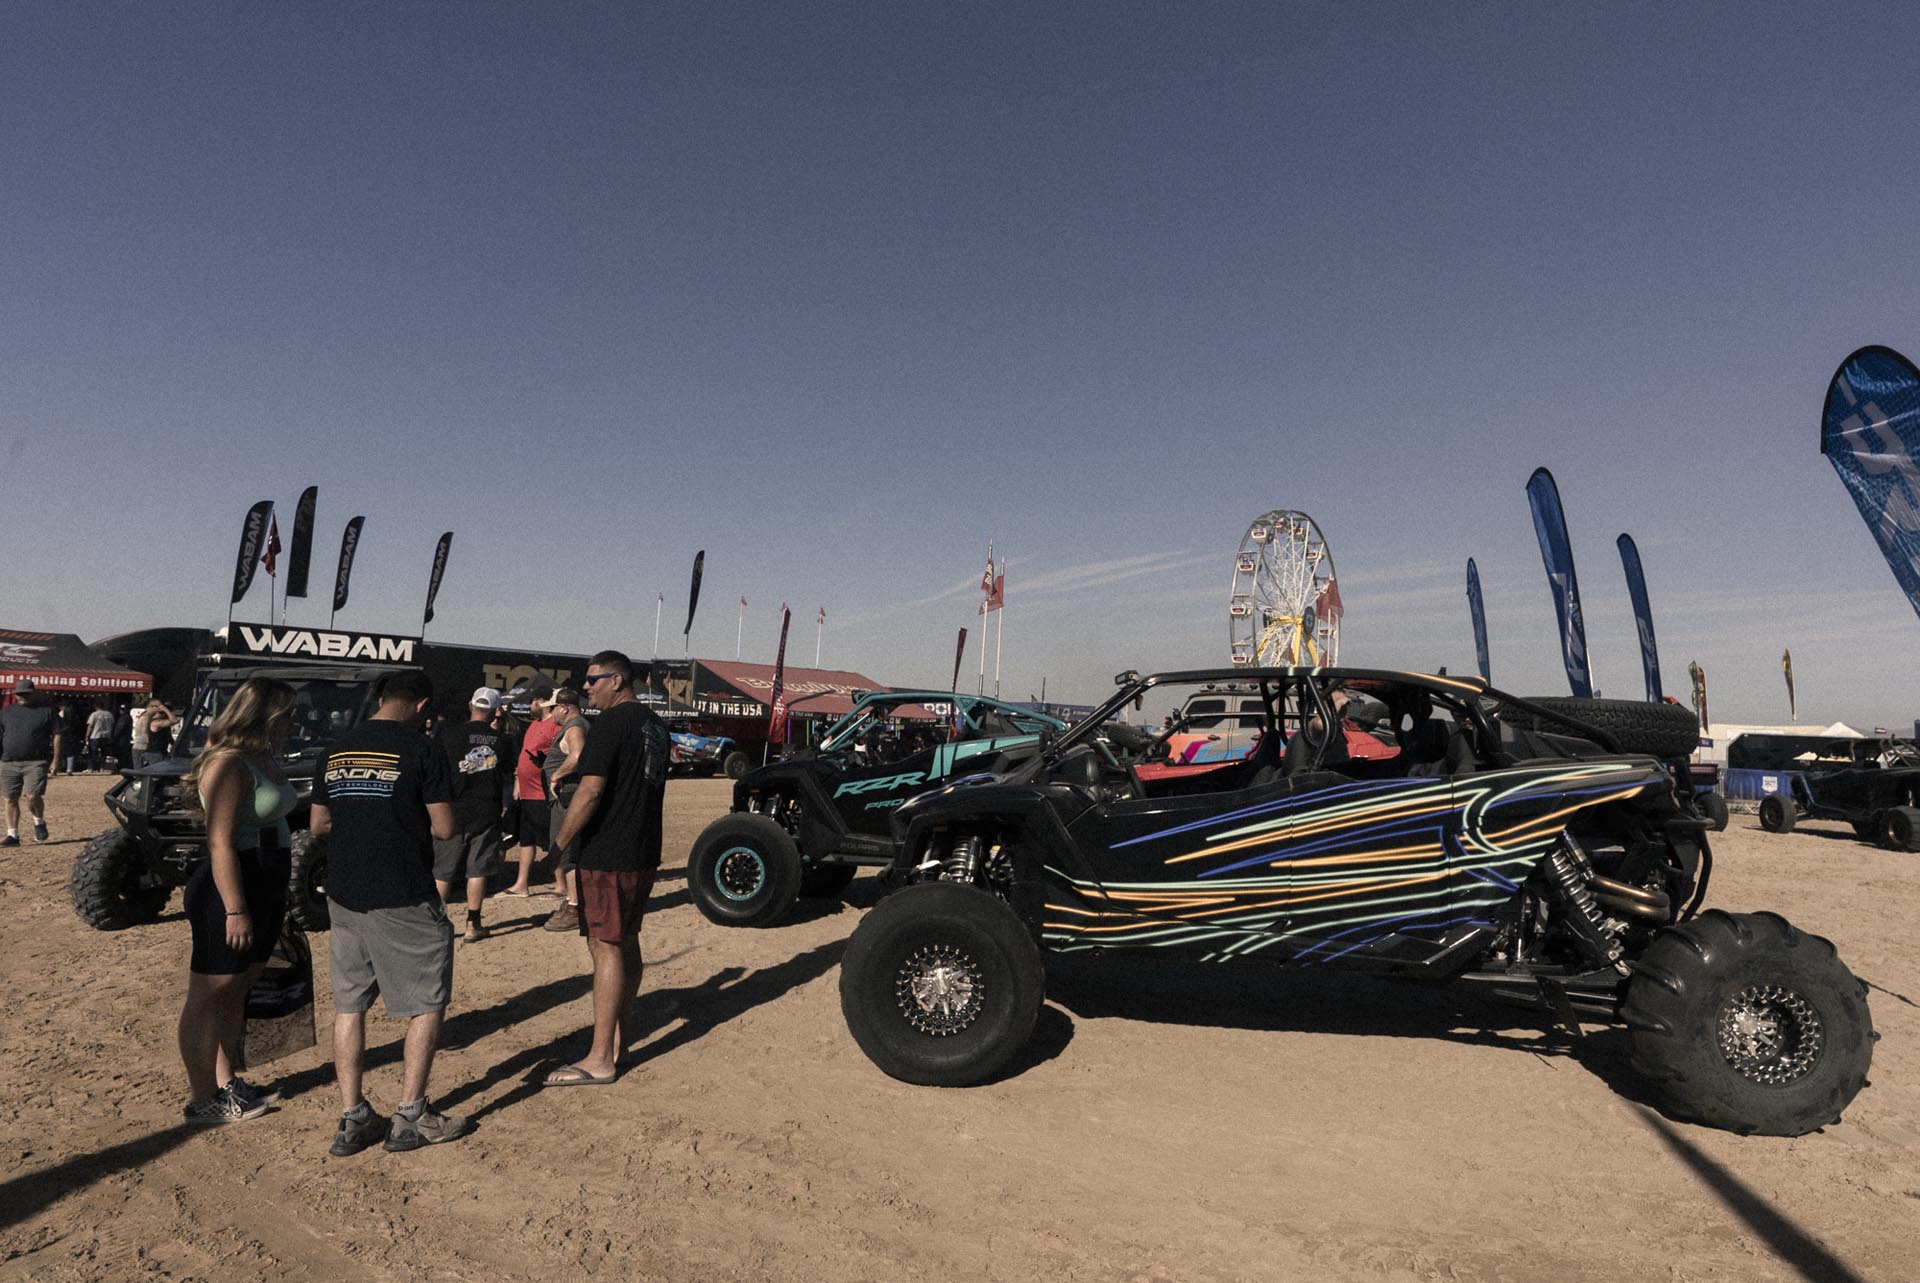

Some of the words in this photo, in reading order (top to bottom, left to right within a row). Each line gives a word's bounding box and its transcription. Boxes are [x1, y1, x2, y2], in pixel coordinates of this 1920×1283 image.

[239, 511, 262, 590] WABAM
[239, 626, 414, 662] WABAM
[80, 676, 144, 688] Solutions
[709, 702, 719, 714] IN
[721, 703, 740, 715] THE
[742, 703, 762, 716] USA
[324, 768, 402, 783] RACING
[832, 771, 926, 799] RZR
